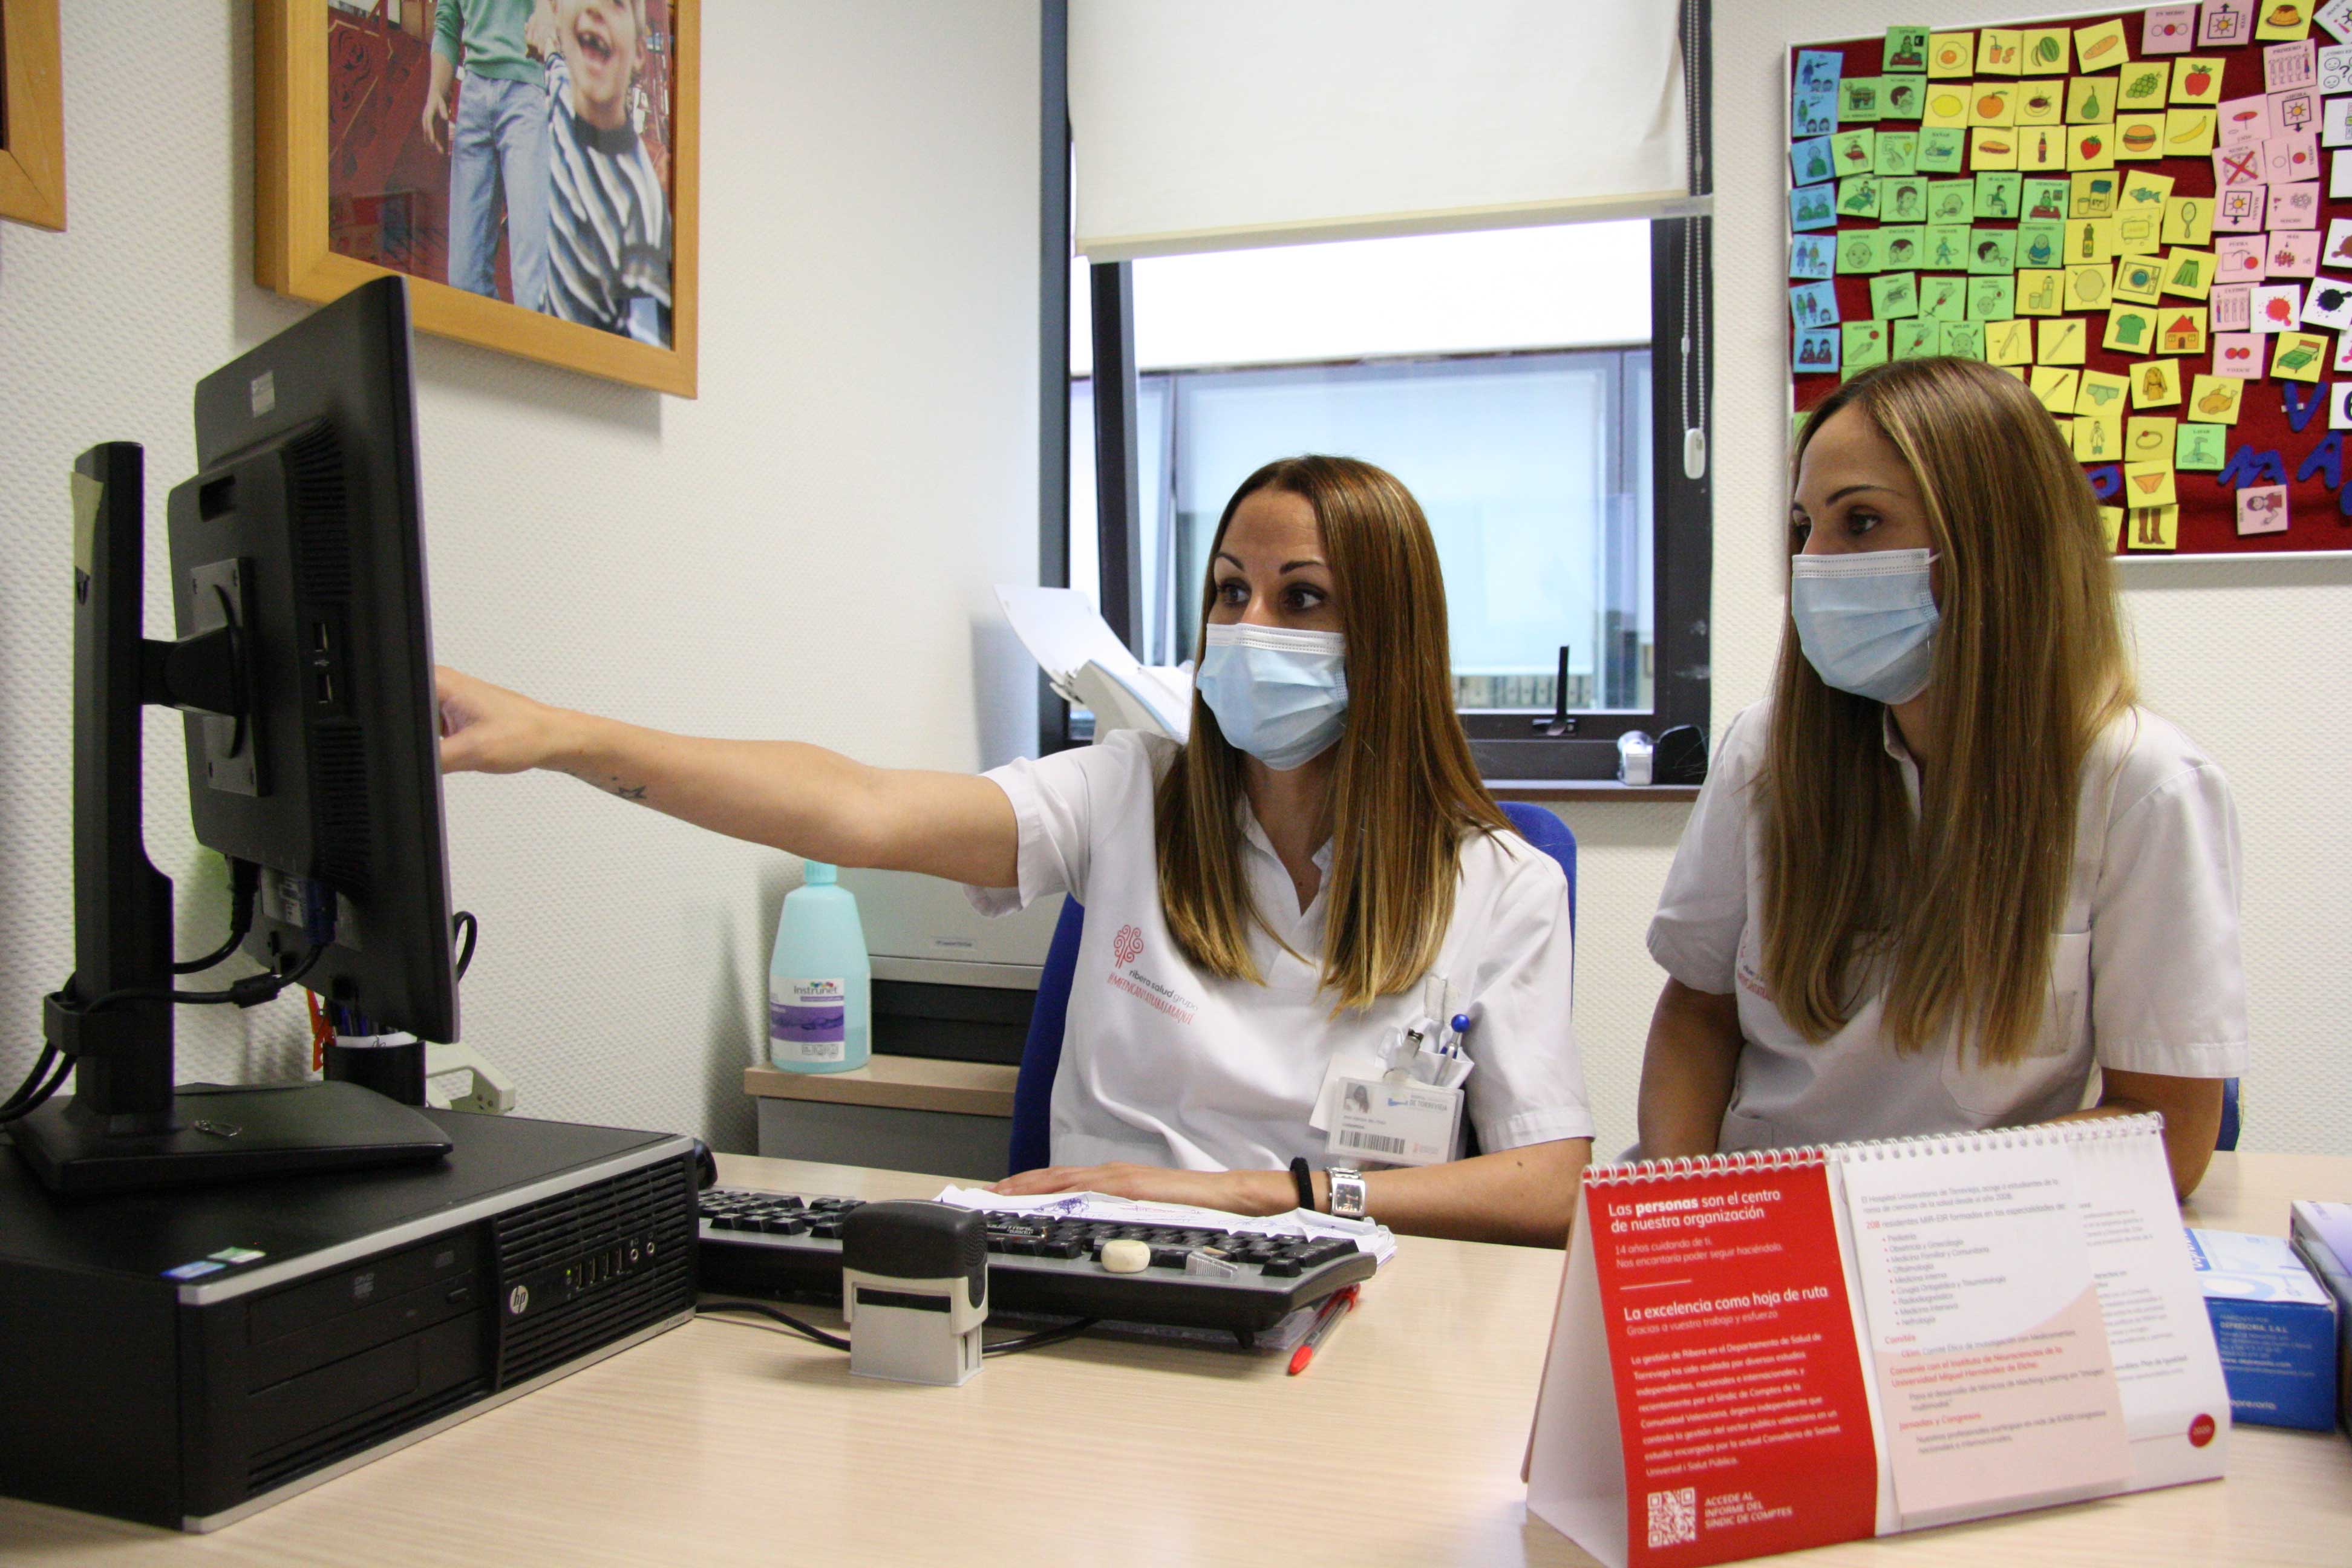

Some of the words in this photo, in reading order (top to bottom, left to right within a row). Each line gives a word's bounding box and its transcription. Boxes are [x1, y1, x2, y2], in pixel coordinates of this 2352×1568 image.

[1129, 969, 1151, 986] ribera
[1151, 983, 1174, 998] salud
[1174, 993, 1198, 1011] grupo
[1609, 1203, 1633, 1216] Las
[1636, 1198, 1699, 1217] personas
[1702, 1196, 1725, 1207] son
[1727, 1192, 1739, 1205] el
[1742, 1191, 1781, 1204] centro
[1612, 1220, 1628, 1232] de
[1630, 1217, 1681, 1230] nuestra
[1684, 1206, 1764, 1227] organización
[1615, 1244, 1626, 1254] 14
[1627, 1243, 1649, 1253] años
[1651, 1238, 1690, 1250] cuidando
[1691, 1237, 1703, 1246] de
[1616, 1258, 1633, 1268] Nos
[1683, 1251, 1708, 1263] poder
[1709, 1247, 1735, 1259] seguir
[512, 1286, 528, 1313] hp
[1625, 1307, 1642, 1321] La
[1645, 1299, 1713, 1318] excelencia
[1715, 1297, 1750, 1310] como
[1753, 1293, 1781, 1307] hoja
[1783, 1289, 1800, 1302] de
[1802, 1287, 1828, 1299] ruta
[1627, 1324, 1660, 1336] Gracias
[1669, 1321, 1702, 1330] vuestro
[1703, 1316, 1733, 1327] trabajo
[1742, 1312, 1777, 1322] esfuerzo
